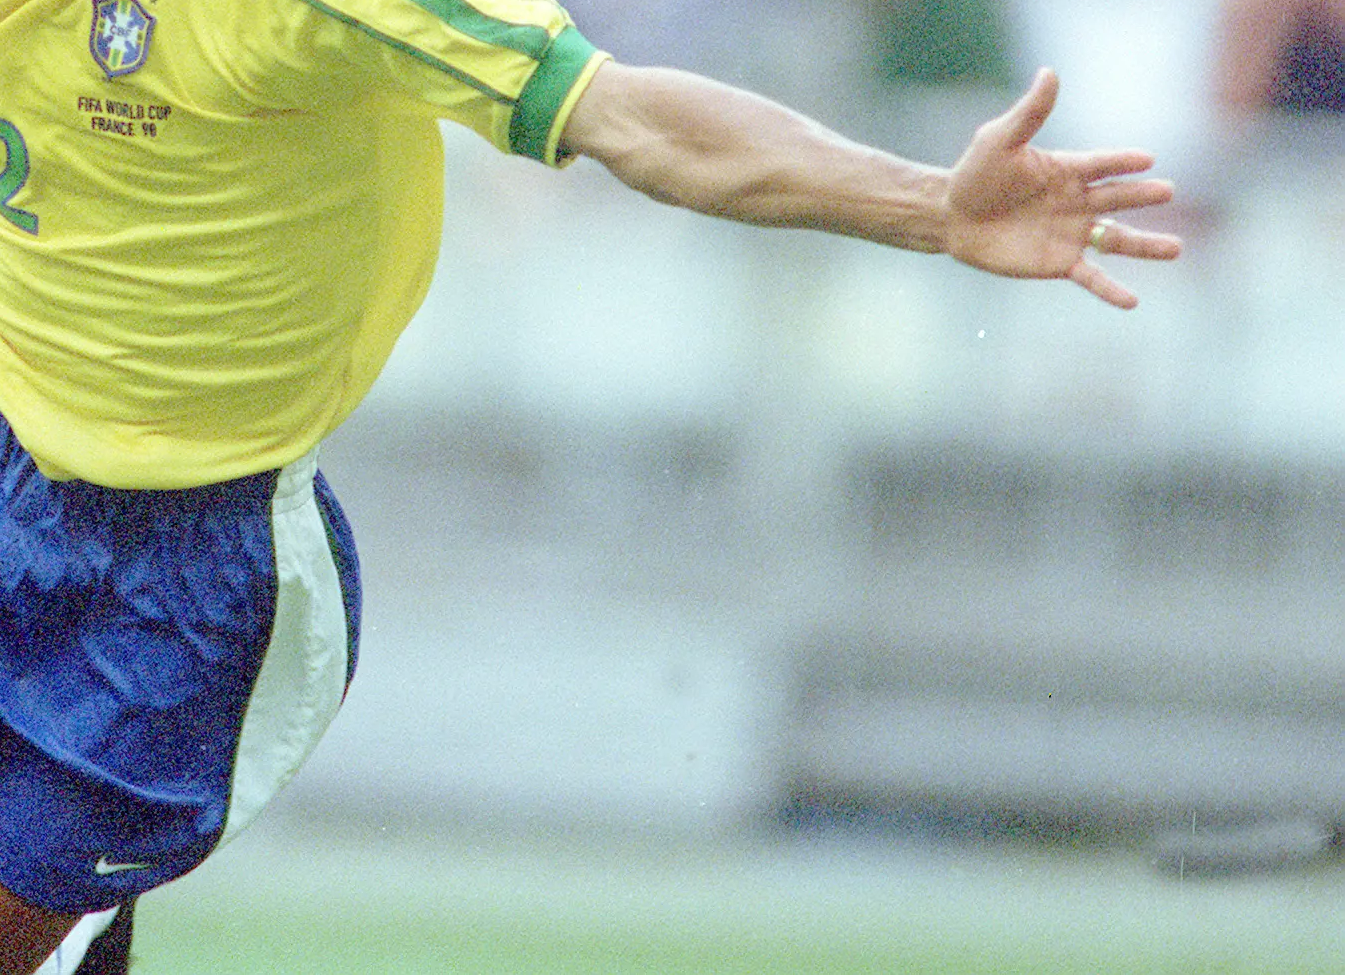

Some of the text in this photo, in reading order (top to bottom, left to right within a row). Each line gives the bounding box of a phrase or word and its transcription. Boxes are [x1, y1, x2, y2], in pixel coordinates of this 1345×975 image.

[78, 96, 172, 121] FIFA WORLD CUP
[91, 117, 134, 137] FRANCE
